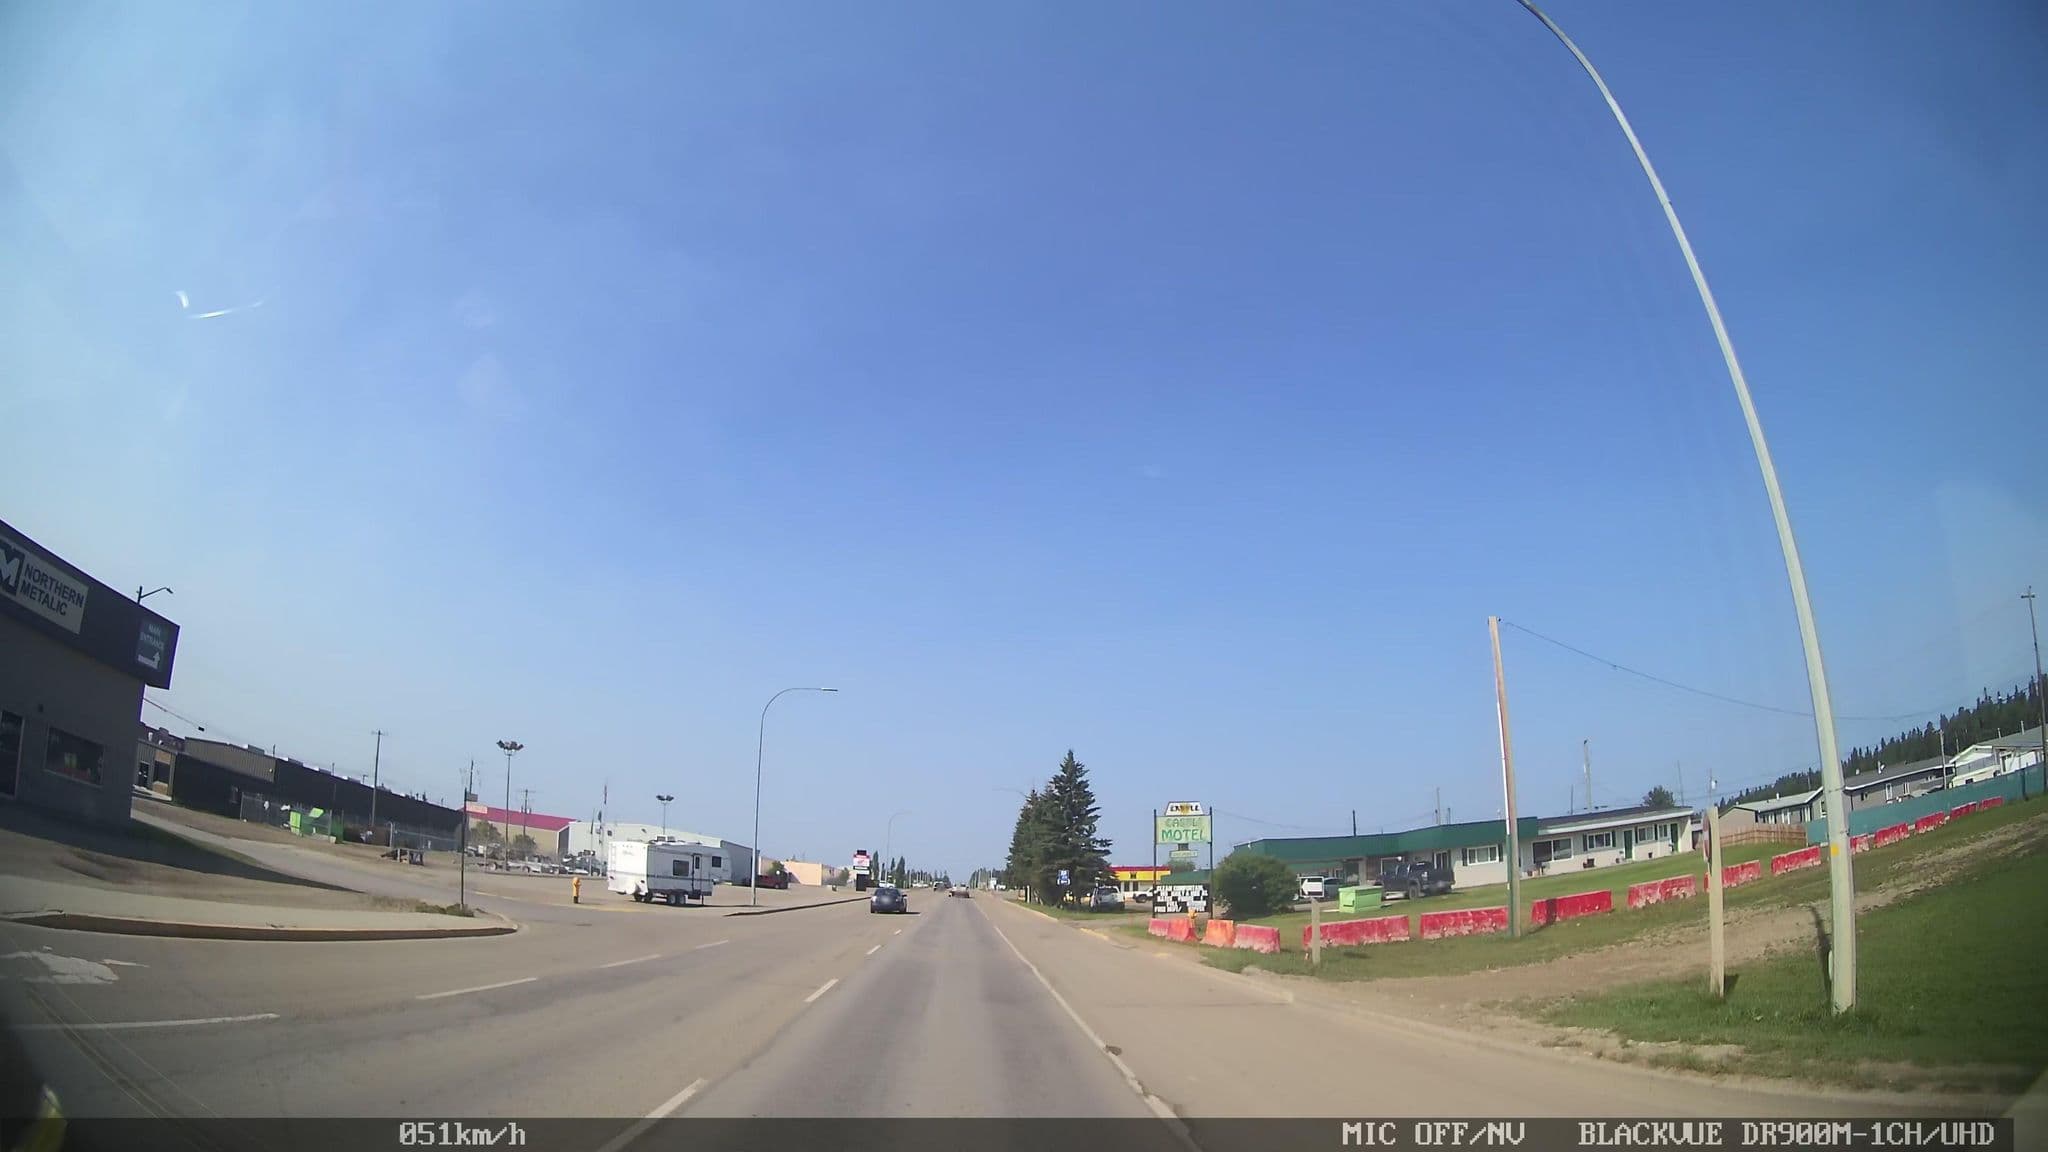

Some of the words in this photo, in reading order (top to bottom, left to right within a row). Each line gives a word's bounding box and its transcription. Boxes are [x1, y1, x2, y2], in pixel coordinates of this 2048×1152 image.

[20, 580, 67, 616] METALIC
[24, 563, 84, 608] NORTHERN
[1161, 828, 1206, 842] MOTEL
